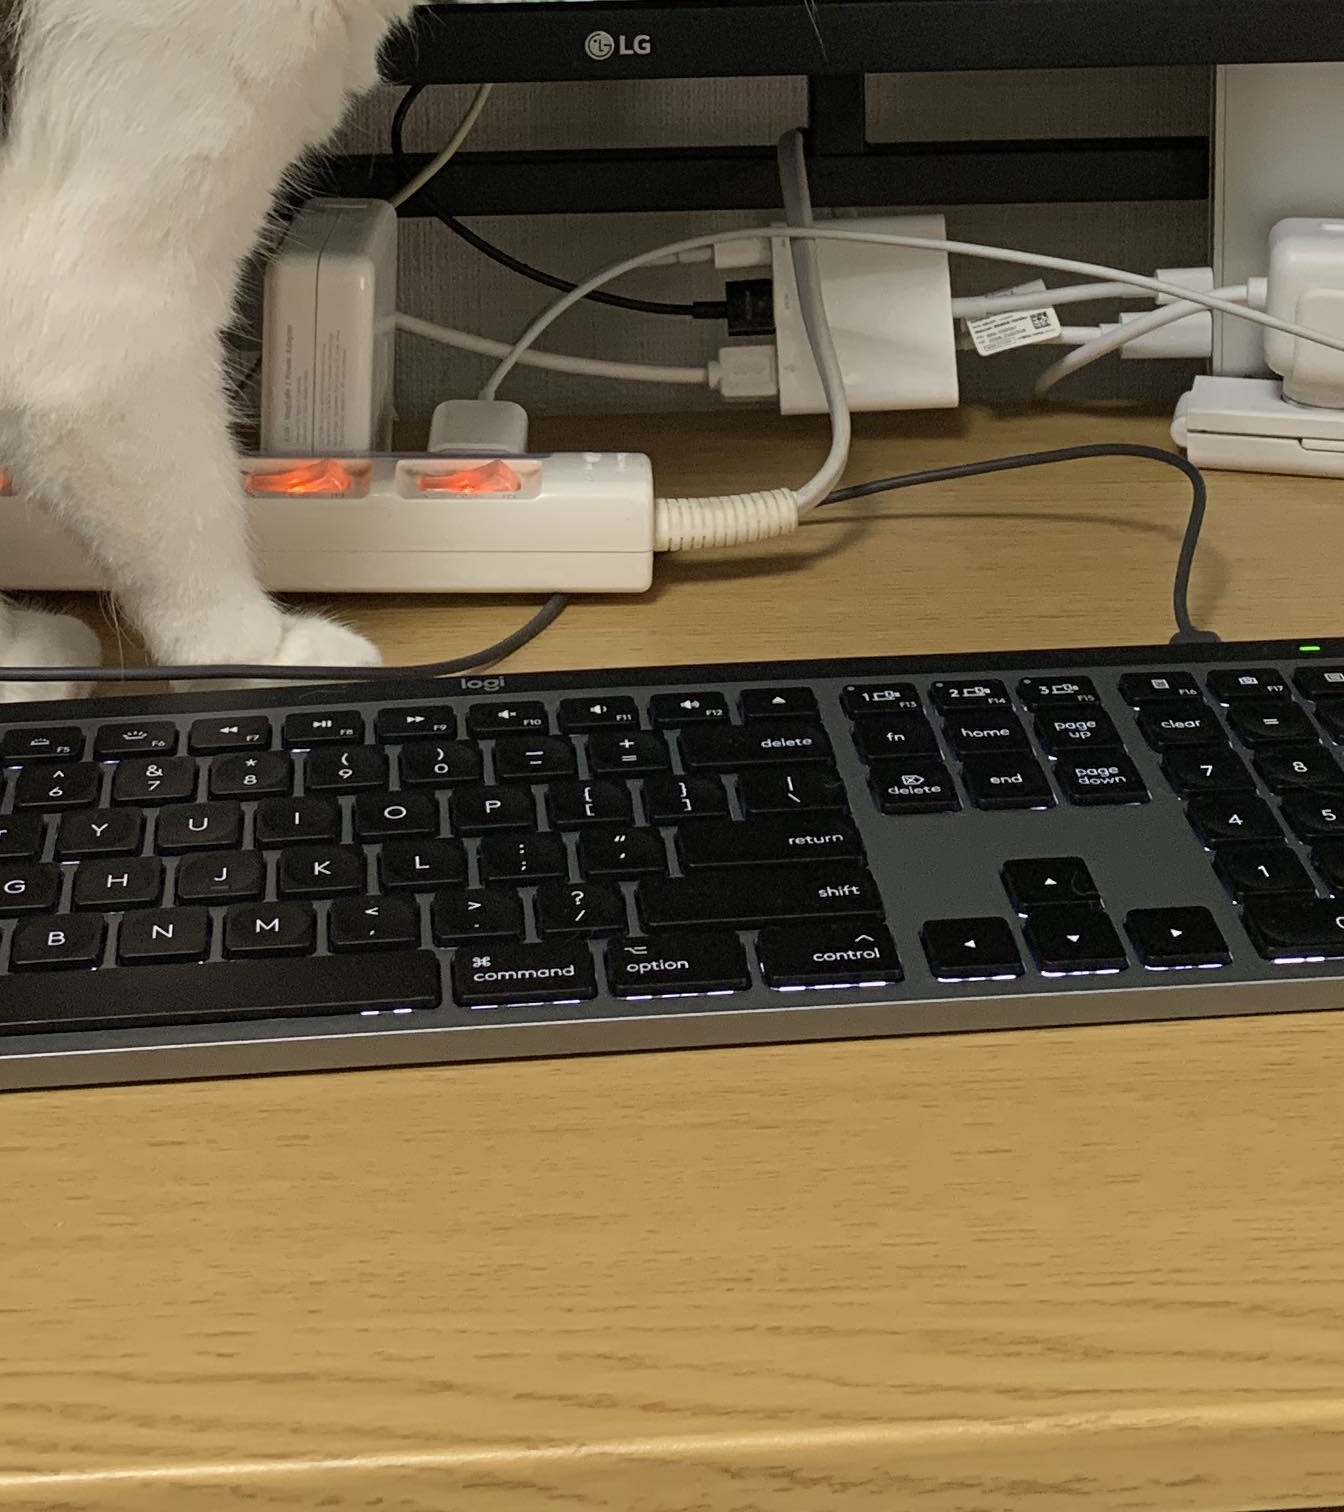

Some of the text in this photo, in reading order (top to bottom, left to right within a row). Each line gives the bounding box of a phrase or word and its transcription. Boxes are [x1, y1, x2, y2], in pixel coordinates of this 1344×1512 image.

[619, 34, 651, 55] LG
[461, 676, 505, 692] logi
[522, 718, 542, 726] F10
[1054, 720, 1096, 732] page
[1160, 719, 1201, 729] clear
[246, 734, 260, 742] F7
[886, 732, 906, 742] fn
[961, 728, 1010, 738] home
[1068, 730, 1092, 740] up
[152, 740, 166, 748] F6
[760, 738, 813, 748] delete
[56, 746, 72, 754] F5
[146, 764, 163, 778] &
[434, 763, 448, 774] 0
[1076, 766, 1119, 778] page
[1200, 764, 1213, 776] 7
[1292, 761, 1308, 772] 8
[243, 774, 257, 784] 8
[338, 768, 353, 780] 9
[990, 774, 1023, 784] end
[148, 780, 160, 791] 7
[1078, 776, 1126, 785] down
[48, 786, 64, 798] 6
[888, 786, 942, 794] delete
[383, 806, 407, 819] O
[485, 799, 502, 814] P
[294, 812, 300, 824] I
[1228, 814, 1244, 826] 4
[1320, 809, 1336, 821] 5
[90, 822, 110, 837] Y
[188, 817, 208, 831] U
[788, 832, 844, 845] return
[416, 855, 430, 869] L
[214, 867, 228, 882] J
[314, 861, 332, 876] K
[1256, 864, 1270, 878] 1
[106, 873, 128, 888] H
[3, 880, 26, 894] G
[818, 884, 860, 898] shift
[571, 890, 584, 905] ?
[152, 923, 174, 939] N
[256, 918, 280, 933] M
[47, 931, 66, 946] B
[812, 948, 880, 962] control
[626, 958, 690, 974] option
[474, 964, 576, 982] command
